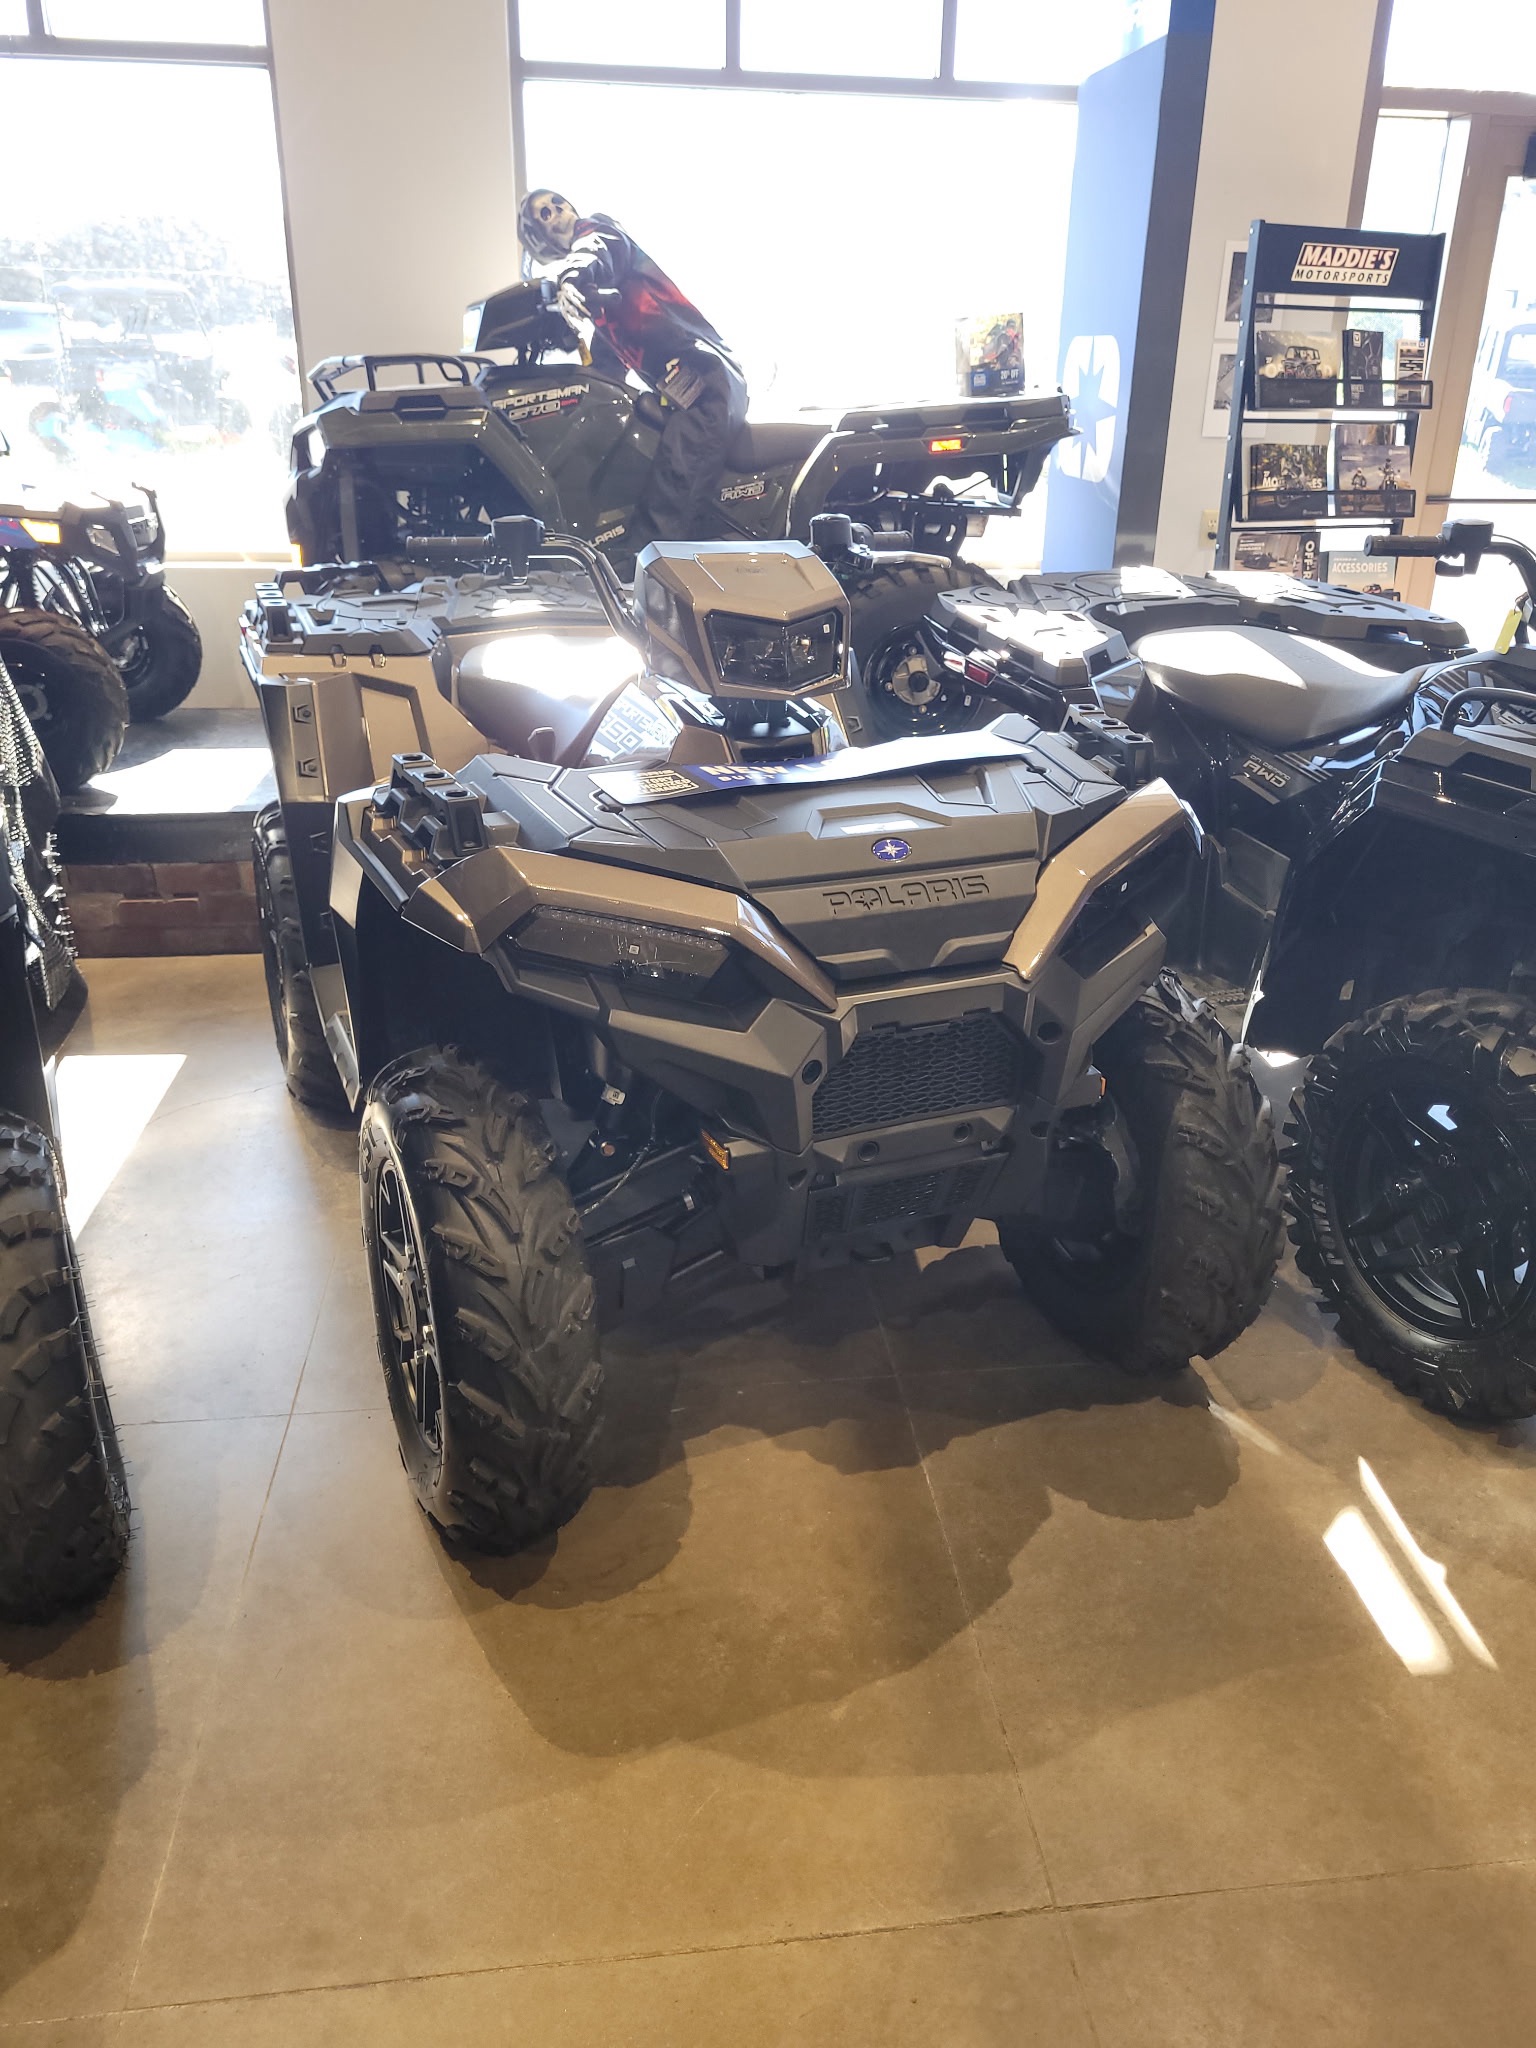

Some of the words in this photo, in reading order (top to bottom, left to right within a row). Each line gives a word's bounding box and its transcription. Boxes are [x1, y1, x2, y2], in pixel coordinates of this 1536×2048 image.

[1301, 245, 1394, 270] MADDIE'S
[1294, 269, 1389, 284] MOTORSPORTS
[492, 384, 590, 410] SPORTSMAN
[509, 400, 560, 420] 570
[588, 525, 626, 548] LARIS
[1332, 562, 1388, 573] ACCESSORIES
[699, 765, 790, 776] NEW
[1243, 760, 1286, 788] AWD
[822, 874, 990, 915] POLARIS
